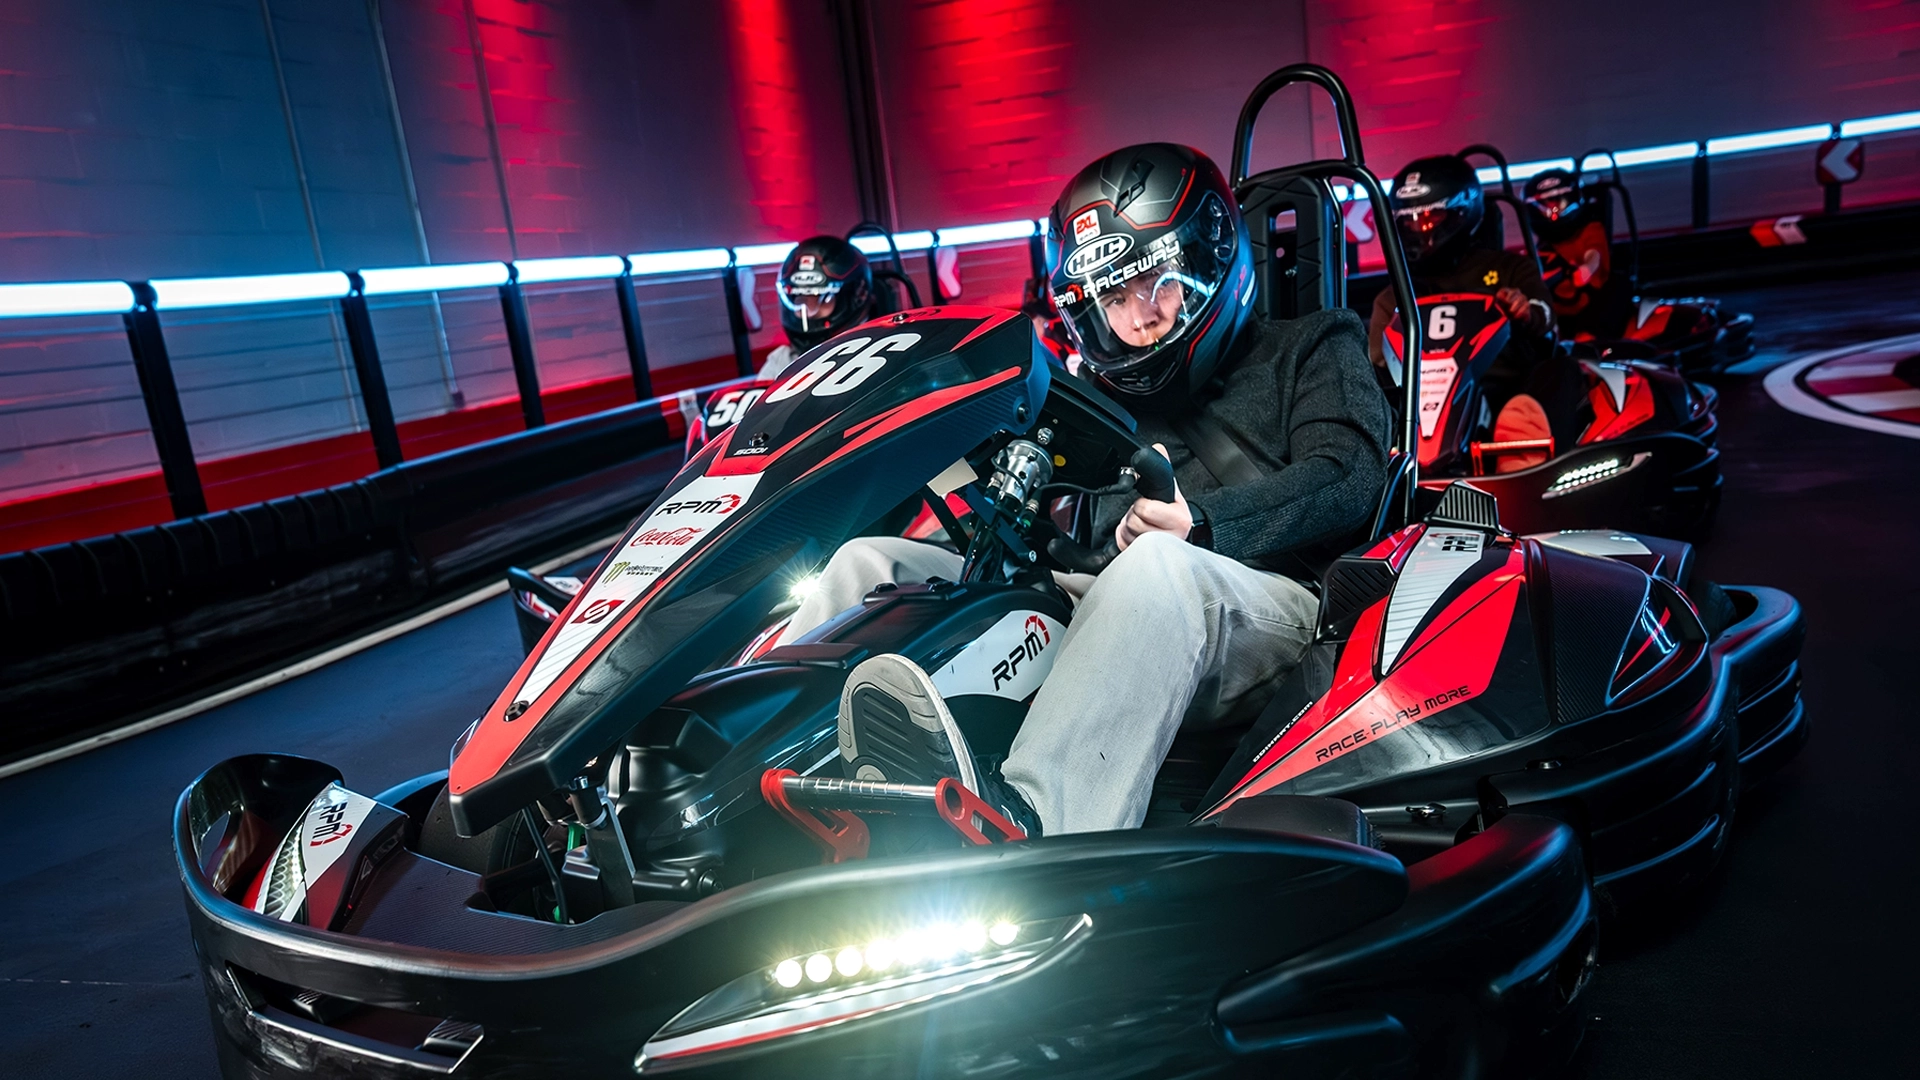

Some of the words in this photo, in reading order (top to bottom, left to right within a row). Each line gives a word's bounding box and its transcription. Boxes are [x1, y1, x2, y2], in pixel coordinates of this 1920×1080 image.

[1072, 238, 1121, 273] HJC
[1082, 240, 1181, 298] RACEWAY
[1428, 304, 1457, 340] 6
[765, 333, 921, 403] 66
[707, 389, 766, 427] 50
[733, 447, 769, 456] SODI
[655, 501, 722, 517] RPM
[992, 631, 1045, 692] RPM
[1424, 685, 1472, 711] MORE
[312, 802, 348, 840] RPM
